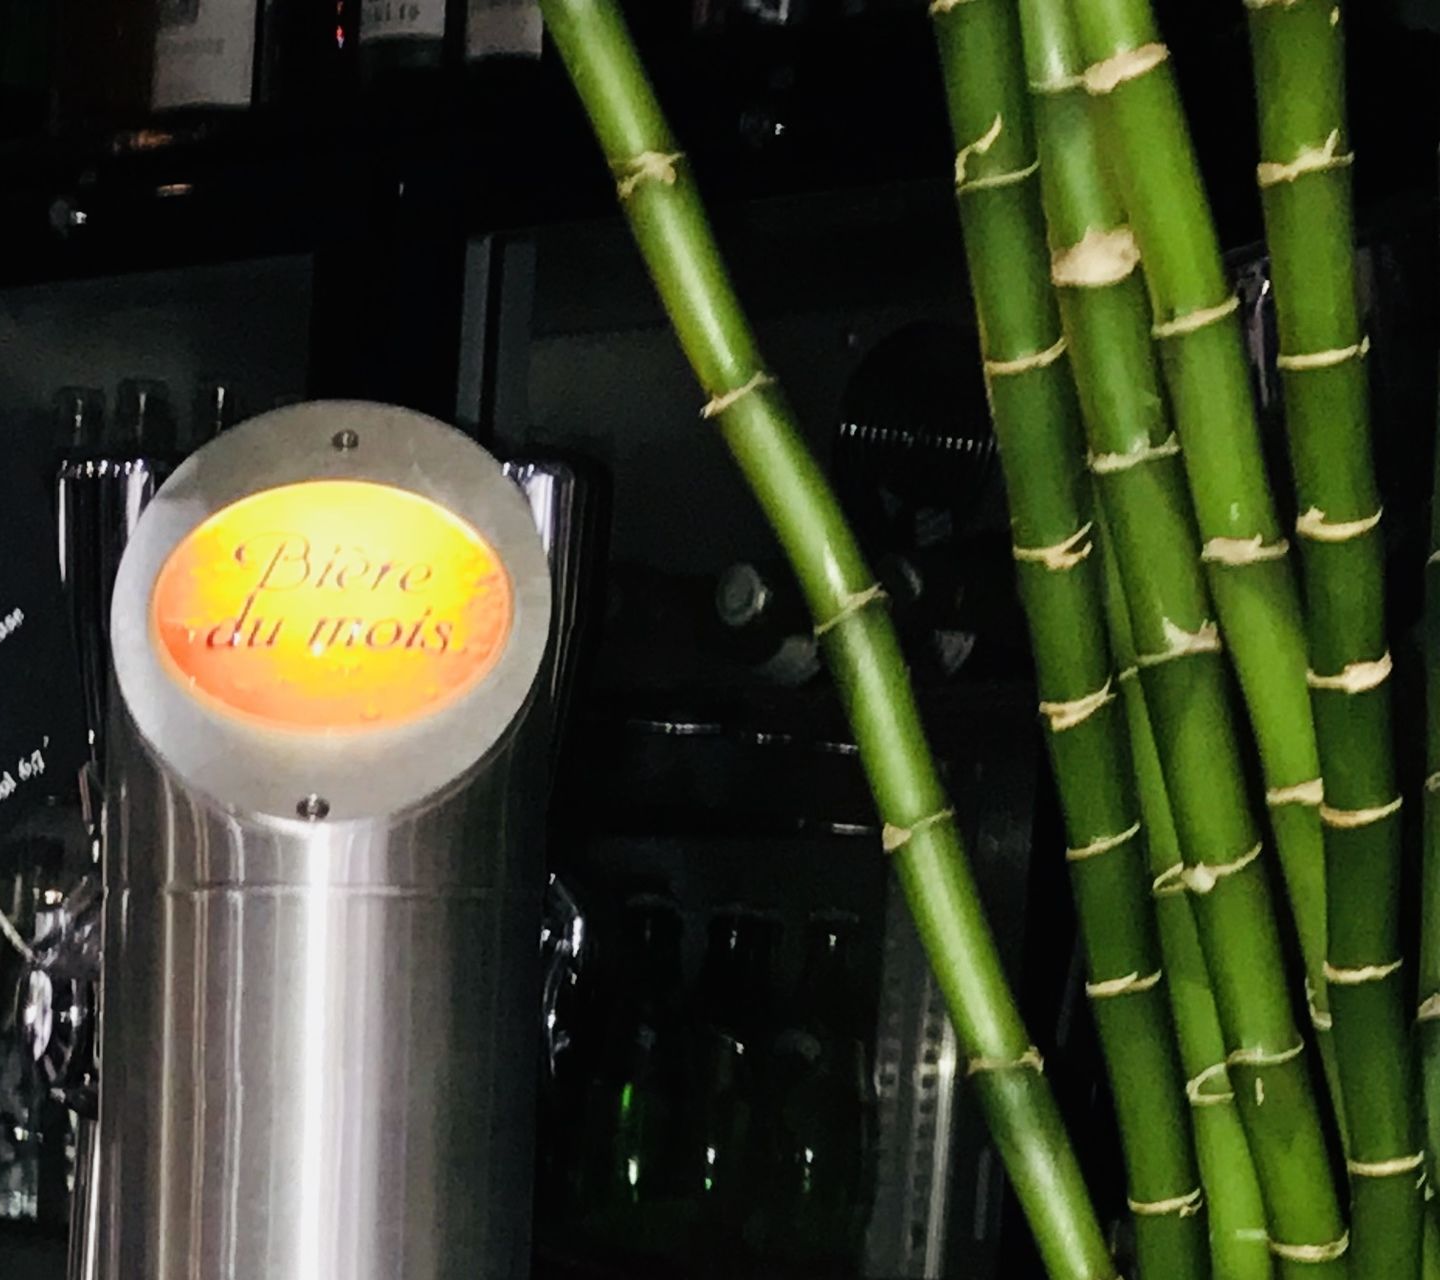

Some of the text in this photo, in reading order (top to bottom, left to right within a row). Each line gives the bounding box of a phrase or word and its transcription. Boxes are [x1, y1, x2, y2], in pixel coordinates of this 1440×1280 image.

[234, 531, 433, 593] Bière
[206, 590, 453, 654] du mois
